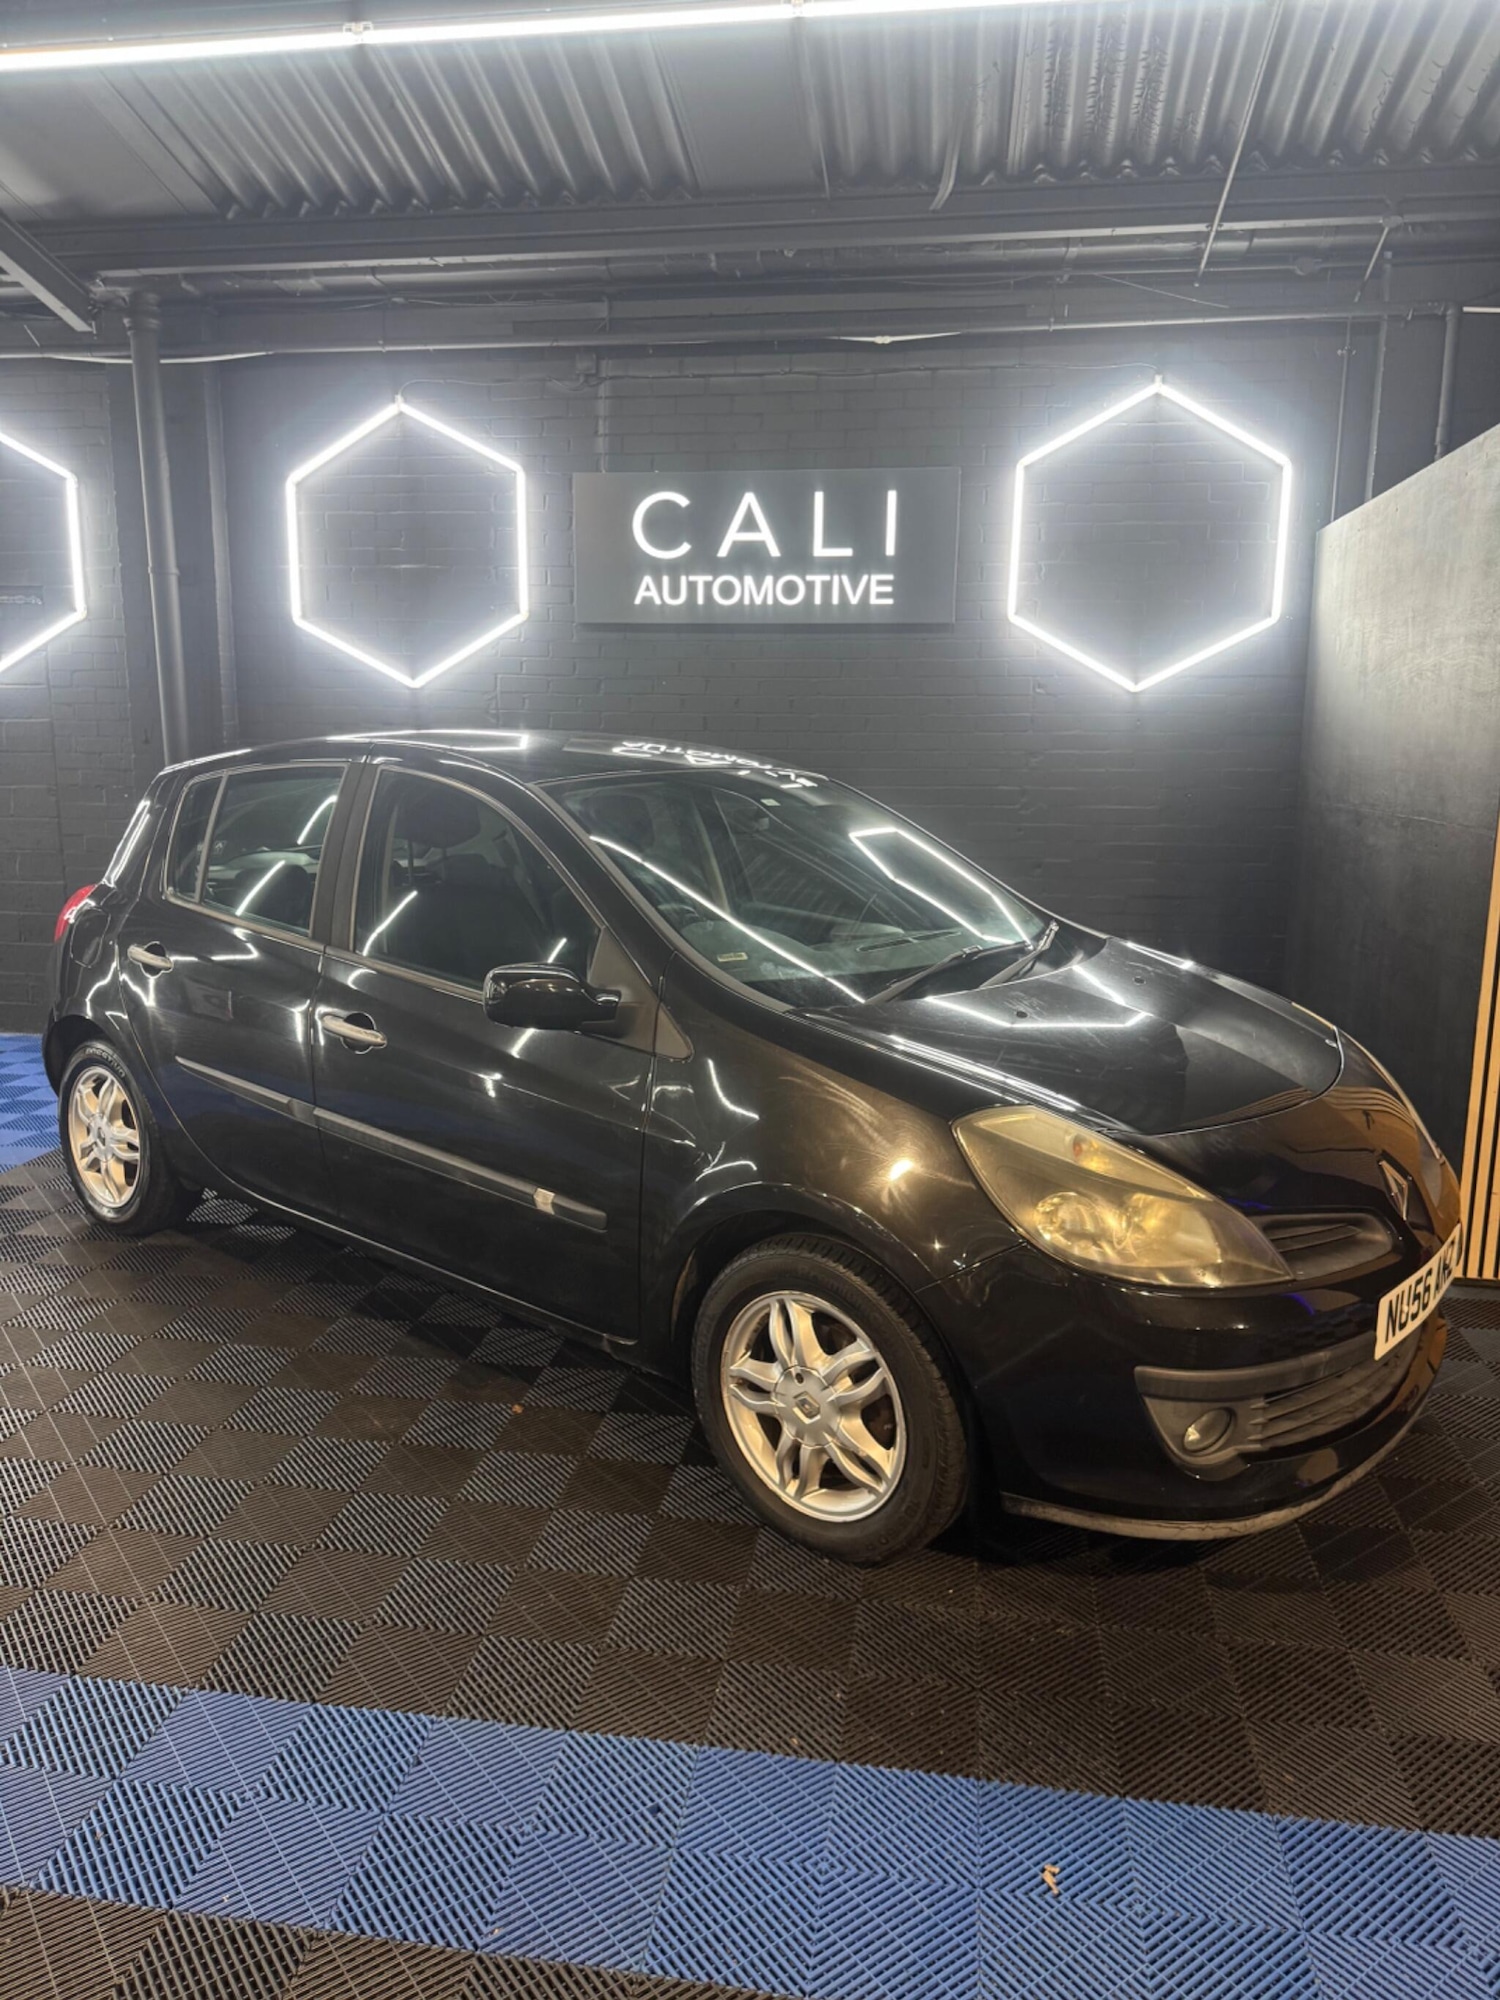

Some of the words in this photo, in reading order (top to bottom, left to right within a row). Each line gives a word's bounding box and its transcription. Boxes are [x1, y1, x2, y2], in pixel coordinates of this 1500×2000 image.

[632, 490, 897, 559] CALI
[634, 574, 895, 605] AUTOMOTIVE
[1385, 1267, 1433, 1343] NU56
